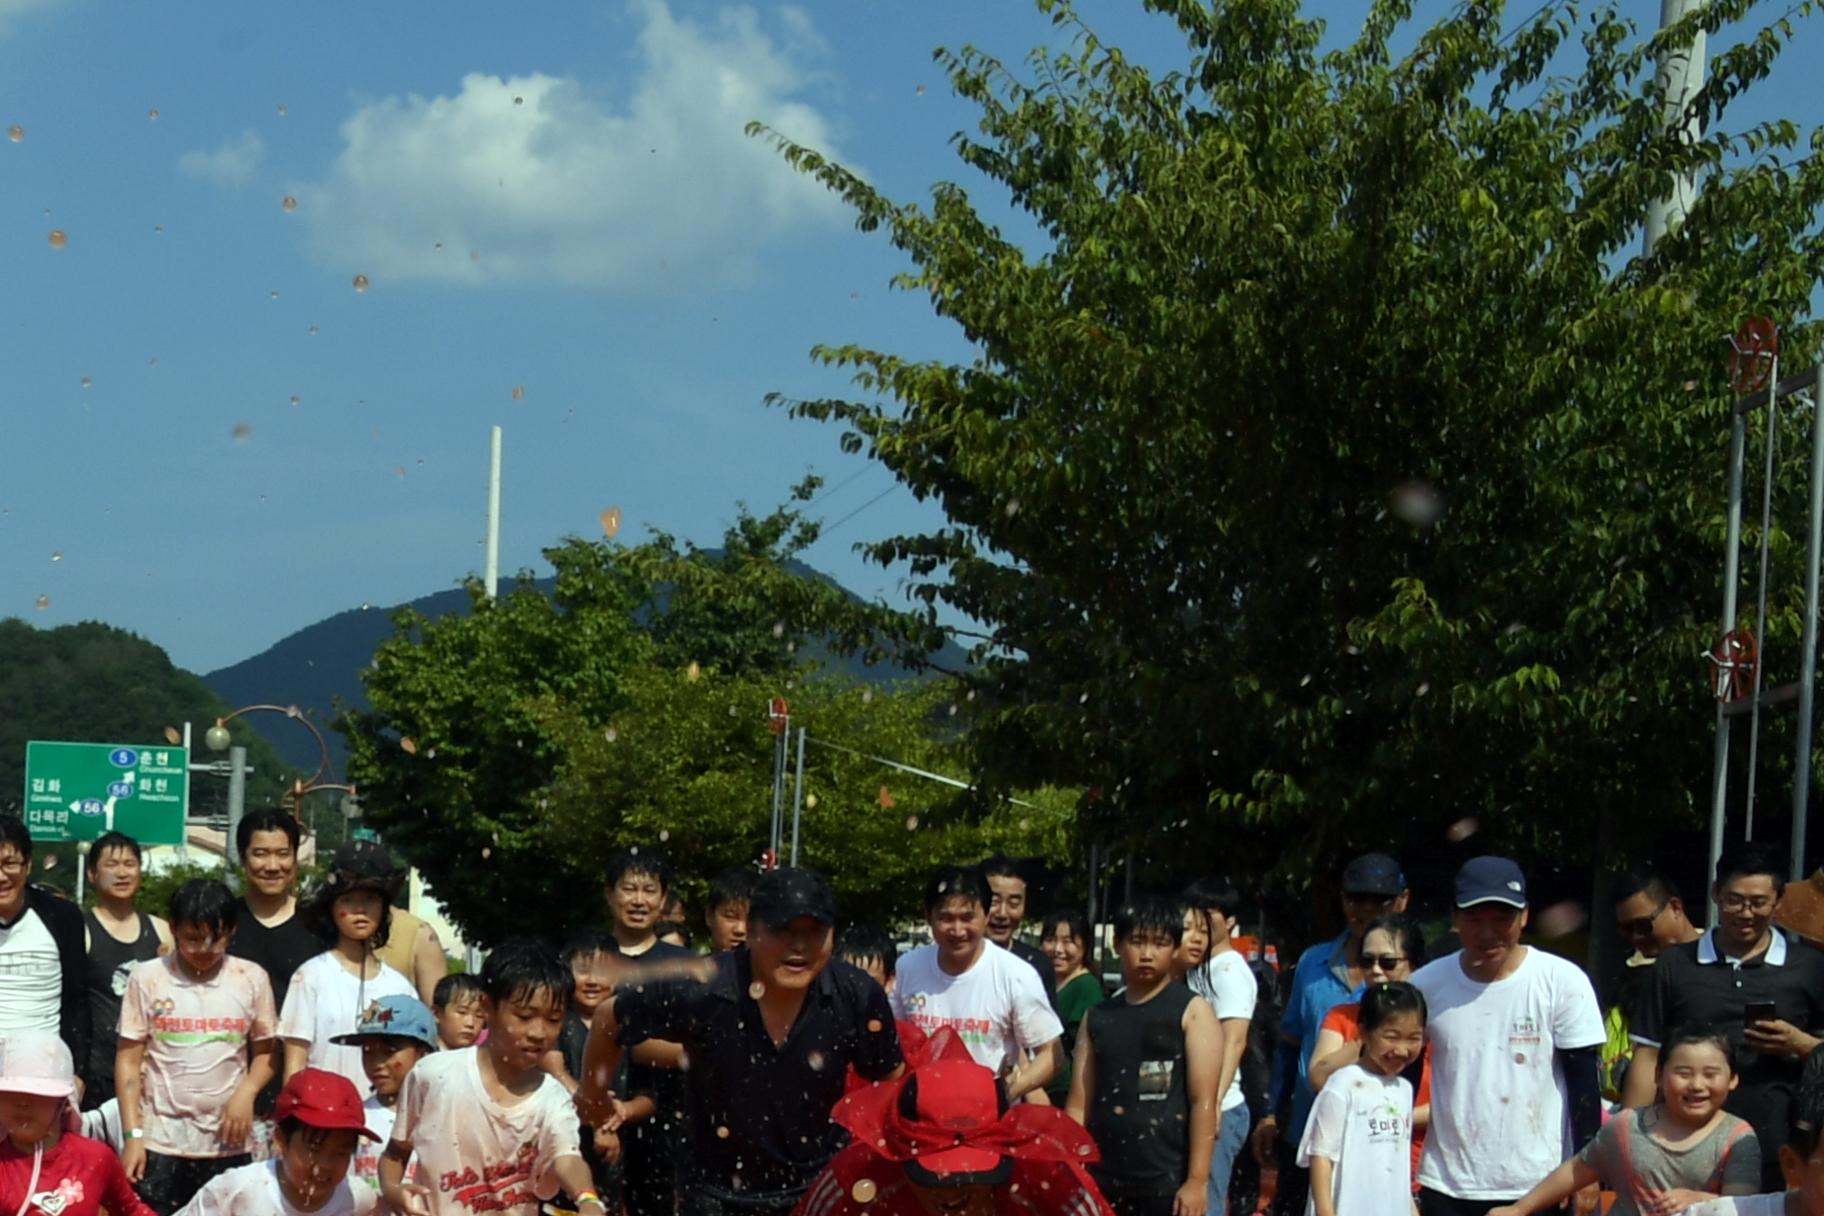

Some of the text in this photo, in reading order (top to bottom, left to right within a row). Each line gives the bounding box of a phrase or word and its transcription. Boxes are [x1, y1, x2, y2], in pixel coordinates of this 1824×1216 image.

[119, 751, 128, 763] 5
[32, 778, 61, 793] 김화
[112, 784, 129, 796] 56
[84, 800, 100, 814] 56
[29, 810, 69, 824] 다목리
